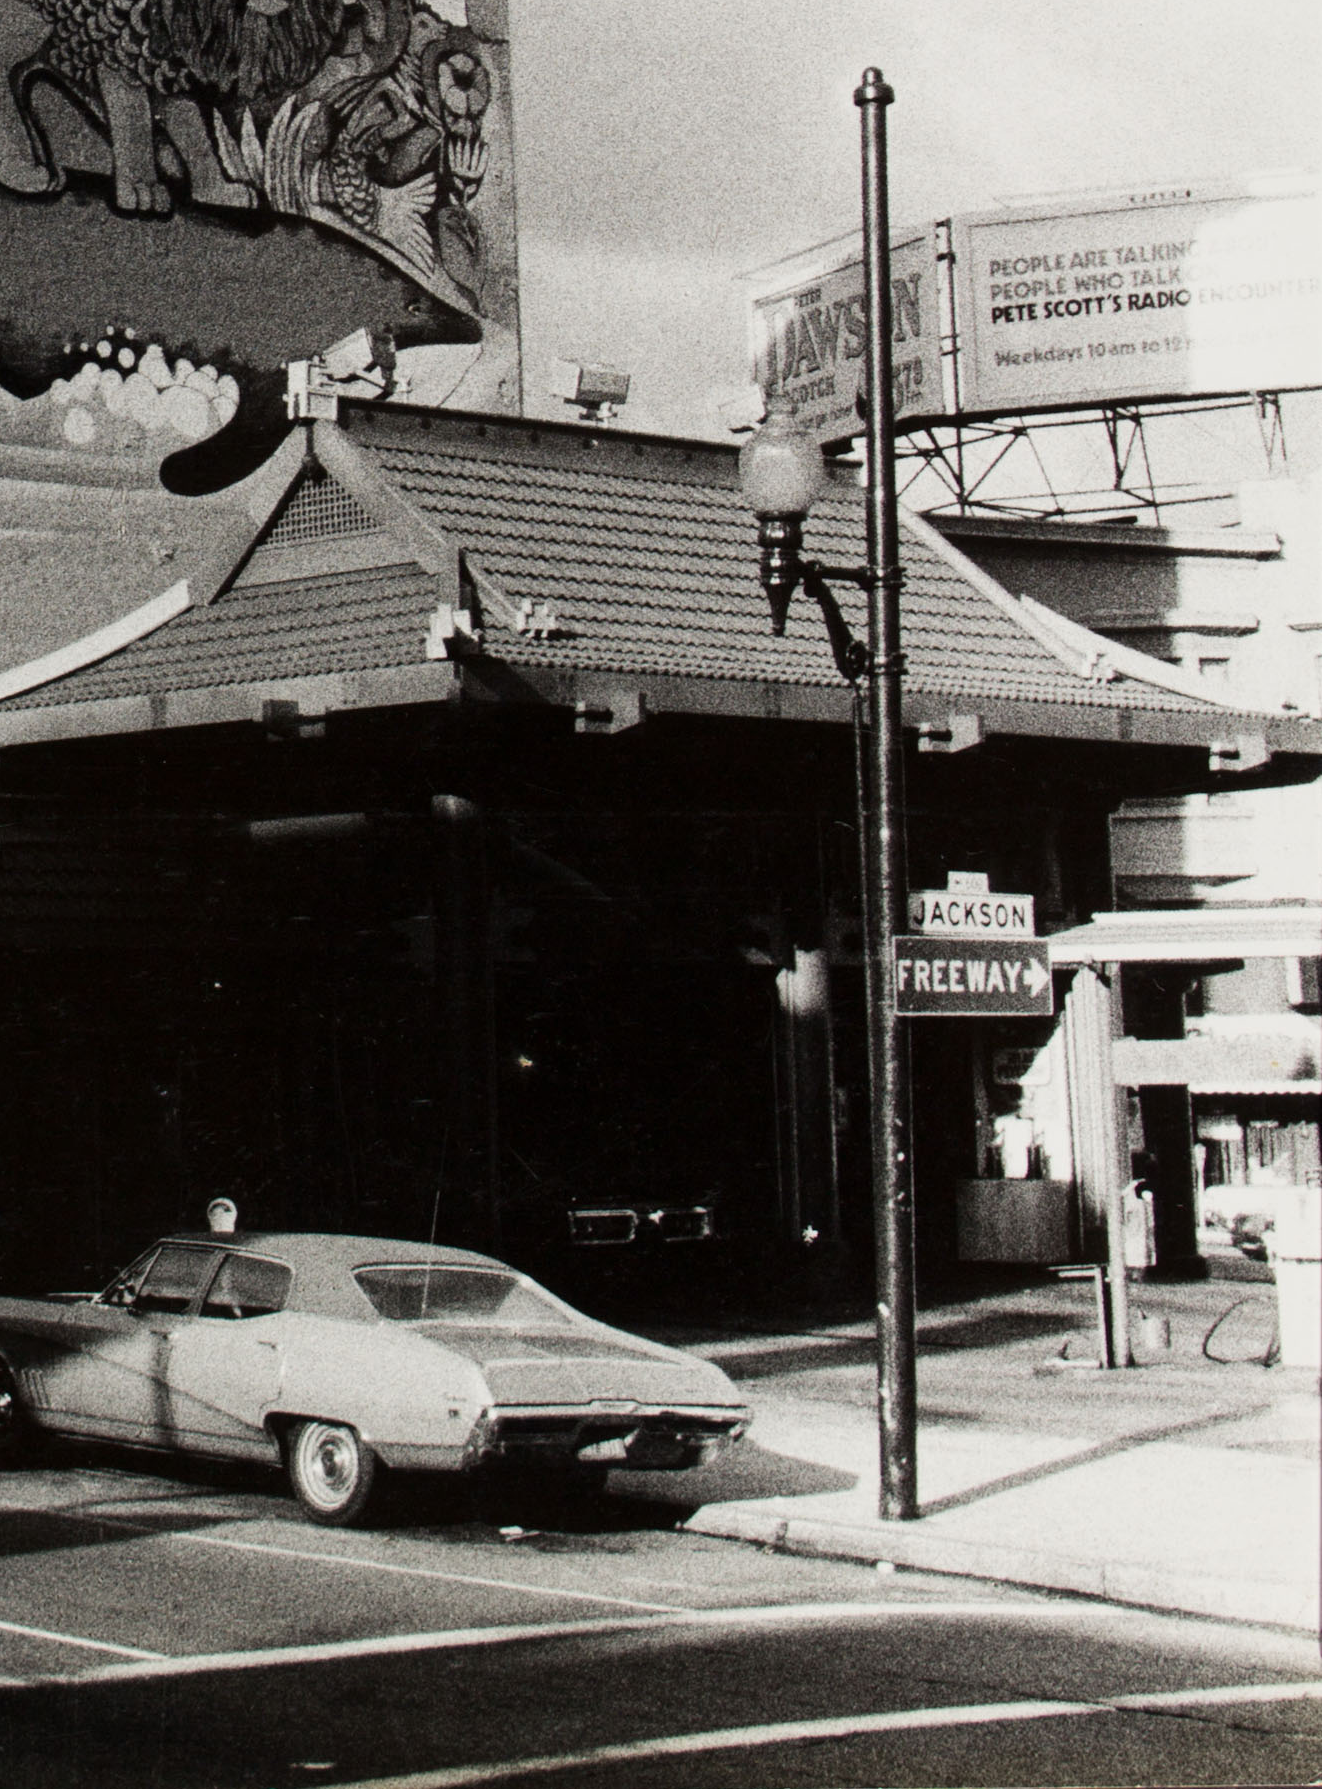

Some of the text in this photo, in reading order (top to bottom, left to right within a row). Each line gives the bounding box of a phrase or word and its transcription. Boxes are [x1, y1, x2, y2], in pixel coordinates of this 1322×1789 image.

[989, 252, 1067, 278] PEOPLE
[1069, 248, 1109, 270] ARE
[1113, 240, 1199, 265] TALKING
[990, 277, 1067, 302] PEOPLE
[1074, 272, 1125, 293] WHO
[1130, 266, 1181, 287] TALK
[991, 302, 1038, 324] PETE
[1044, 293, 1122, 319] SCOTT'S
[1127, 289, 1192, 311] RADIO
[764, 271, 922, 397] DAWSN
[994, 345, 1084, 367] Weekdays
[1087, 341, 1107, 358] 10
[1108, 342, 1136, 356] am
[1141, 340, 1161, 353] to
[913, 900, 1026, 928] JACKSON
[897, 959, 1023, 994] FREEWAY
